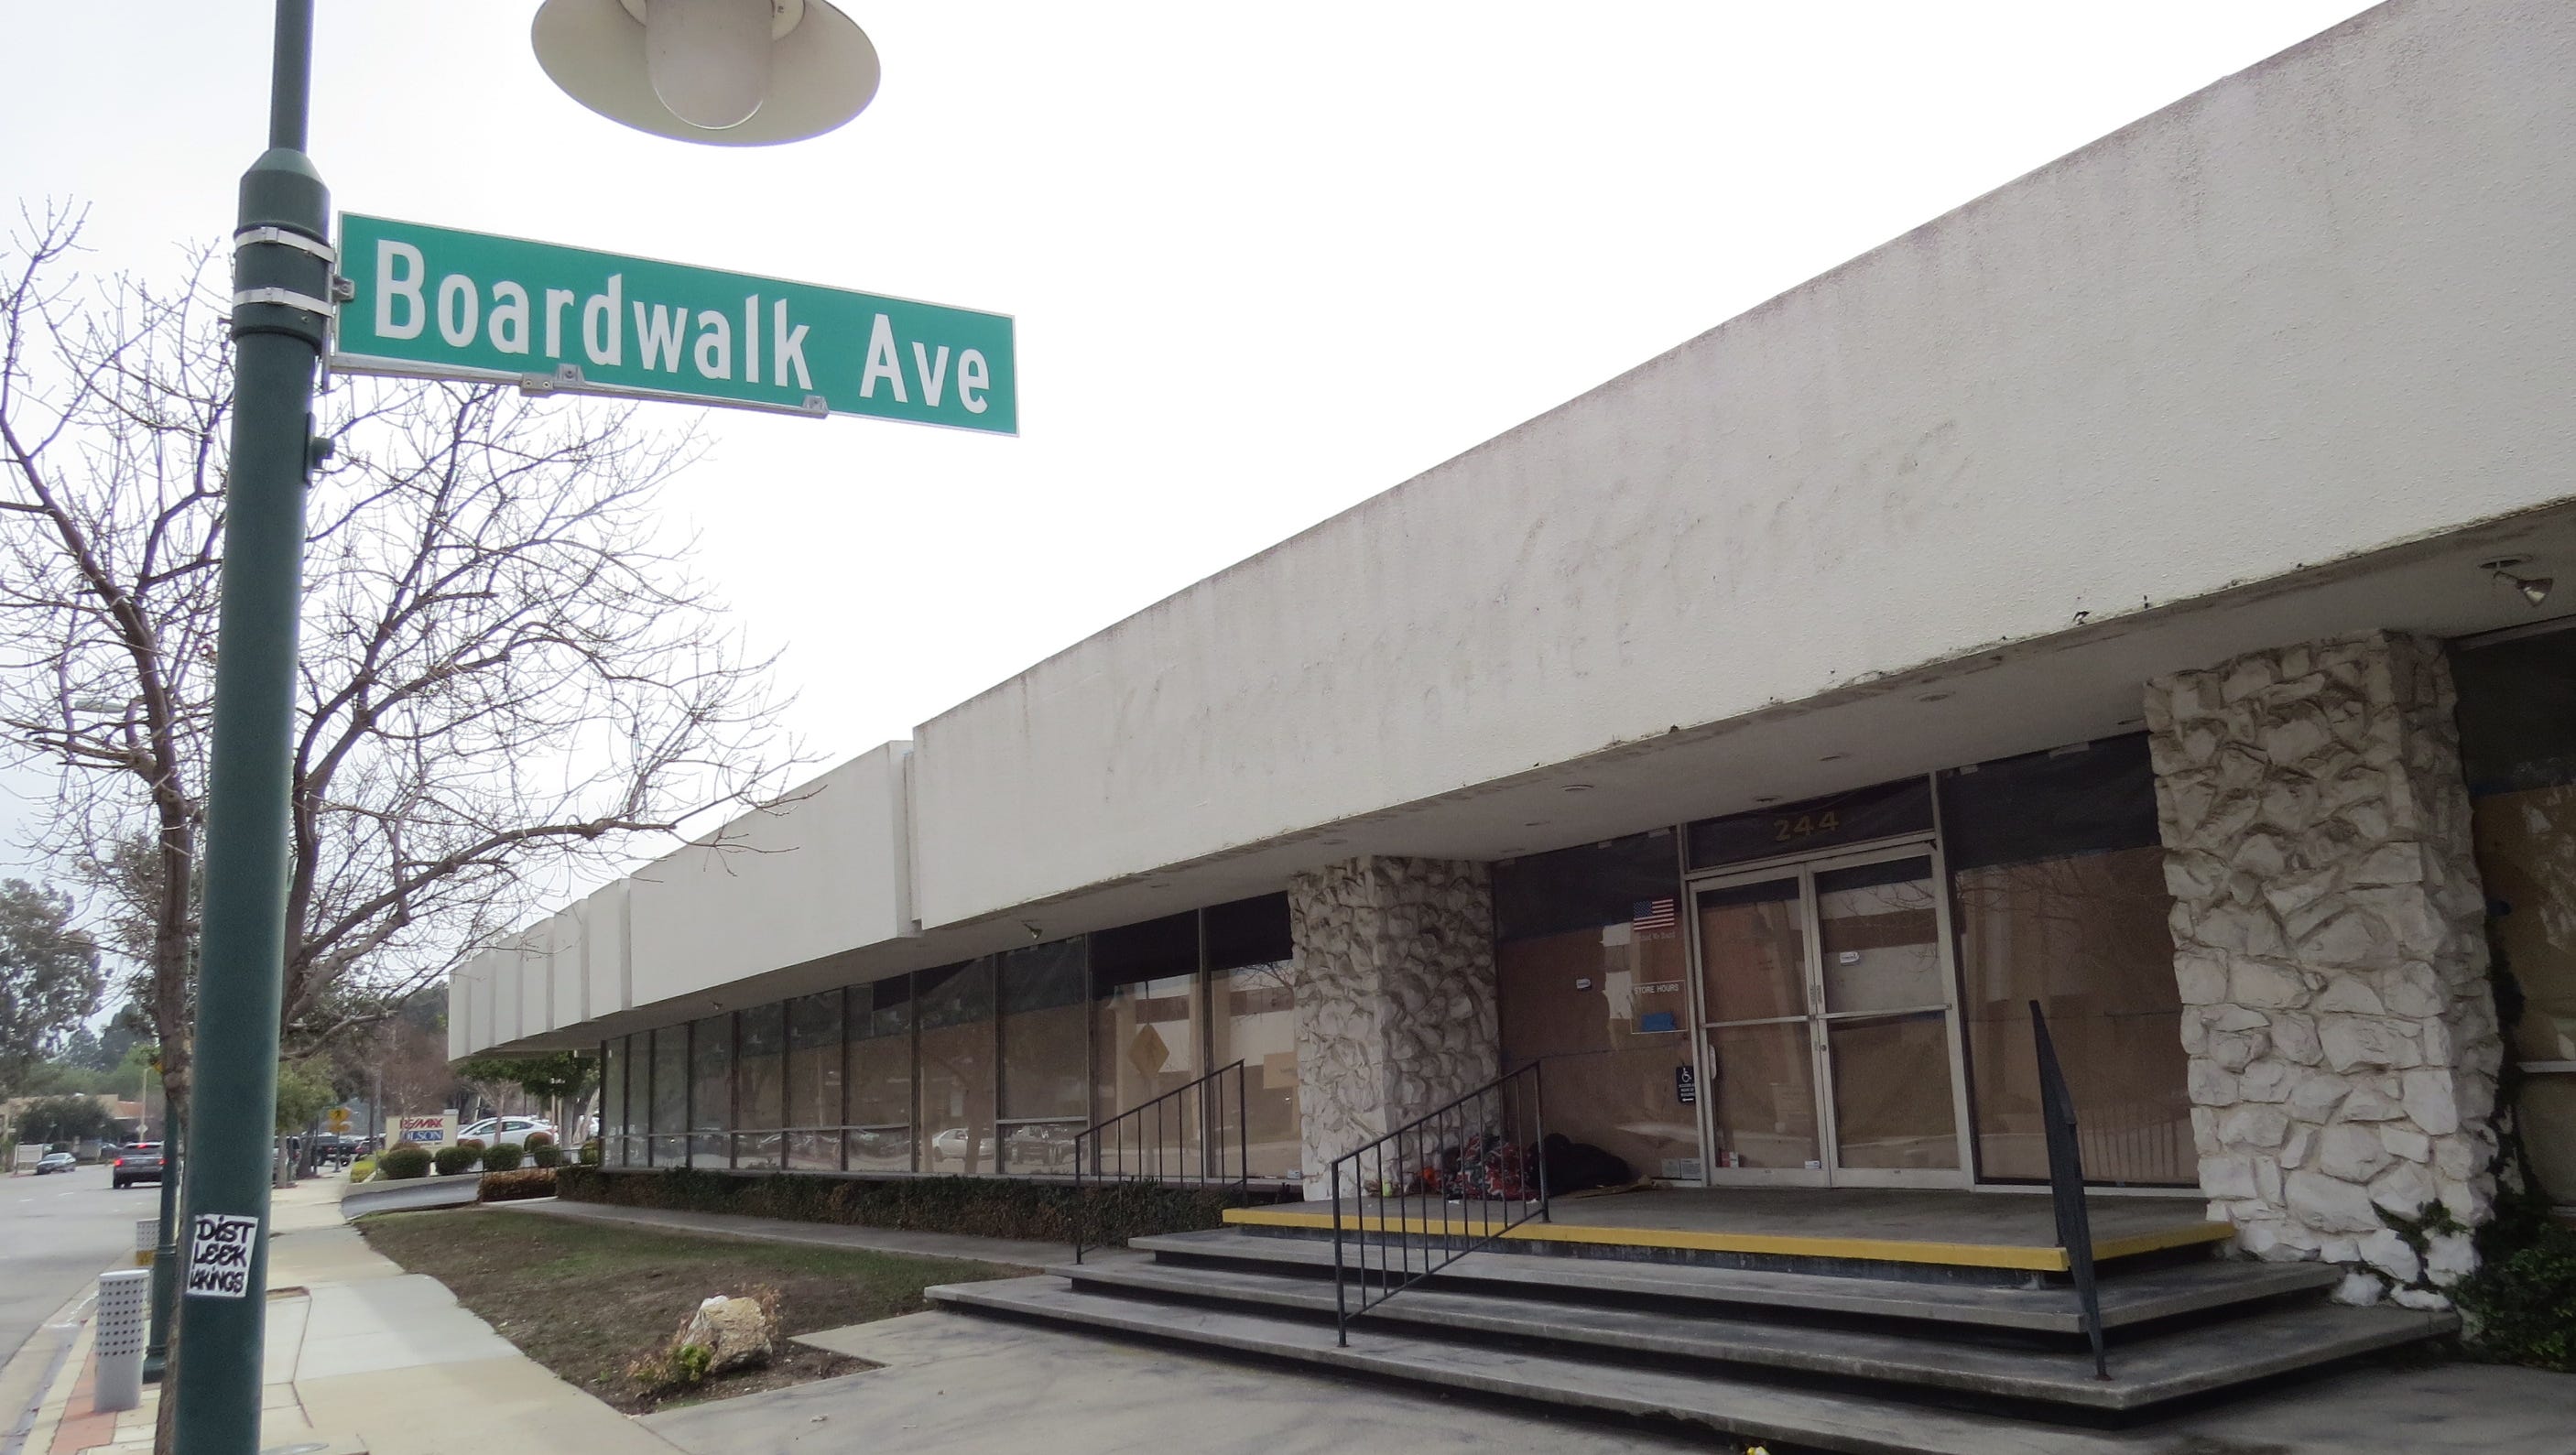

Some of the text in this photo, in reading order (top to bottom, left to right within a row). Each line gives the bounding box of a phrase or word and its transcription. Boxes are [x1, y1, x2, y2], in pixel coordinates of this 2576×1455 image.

[375, 238, 991, 414] Boardwalk Ave
[1774, 811, 1839, 842] 244
[1635, 983, 1679, 995] STORE HOURS
